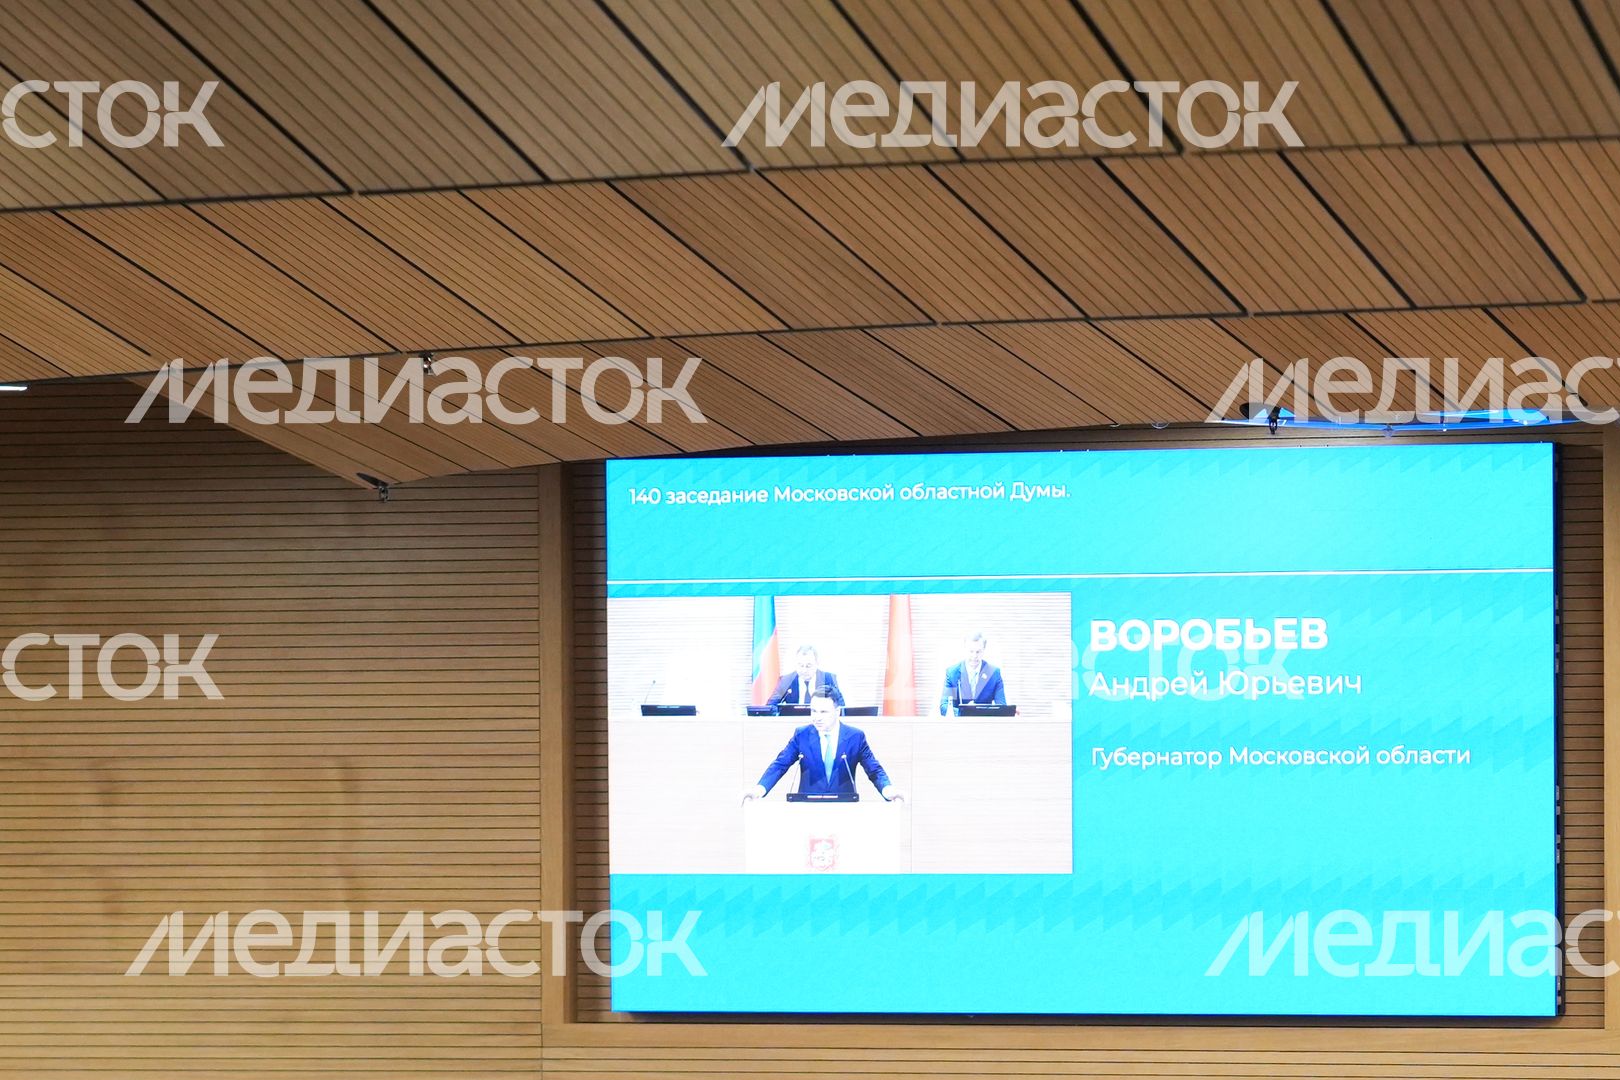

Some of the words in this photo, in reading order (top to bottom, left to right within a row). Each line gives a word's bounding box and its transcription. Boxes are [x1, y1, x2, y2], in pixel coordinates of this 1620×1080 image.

[628, 487, 662, 505] 140
[666, 489, 769, 506] заседание
[774, 484, 895, 503] Московской
[899, 482, 1005, 501] областной
[1009, 481, 1071, 503] Думы.
[1090, 617, 1328, 652] ВОРОБЬЕВ
[1088, 670, 1208, 701] Андрей
[1219, 669, 1361, 701] Юрьевич
[1091, 746, 1223, 771] Губернатор
[1229, 745, 1370, 766] Московской
[1376, 745, 1471, 765] области
